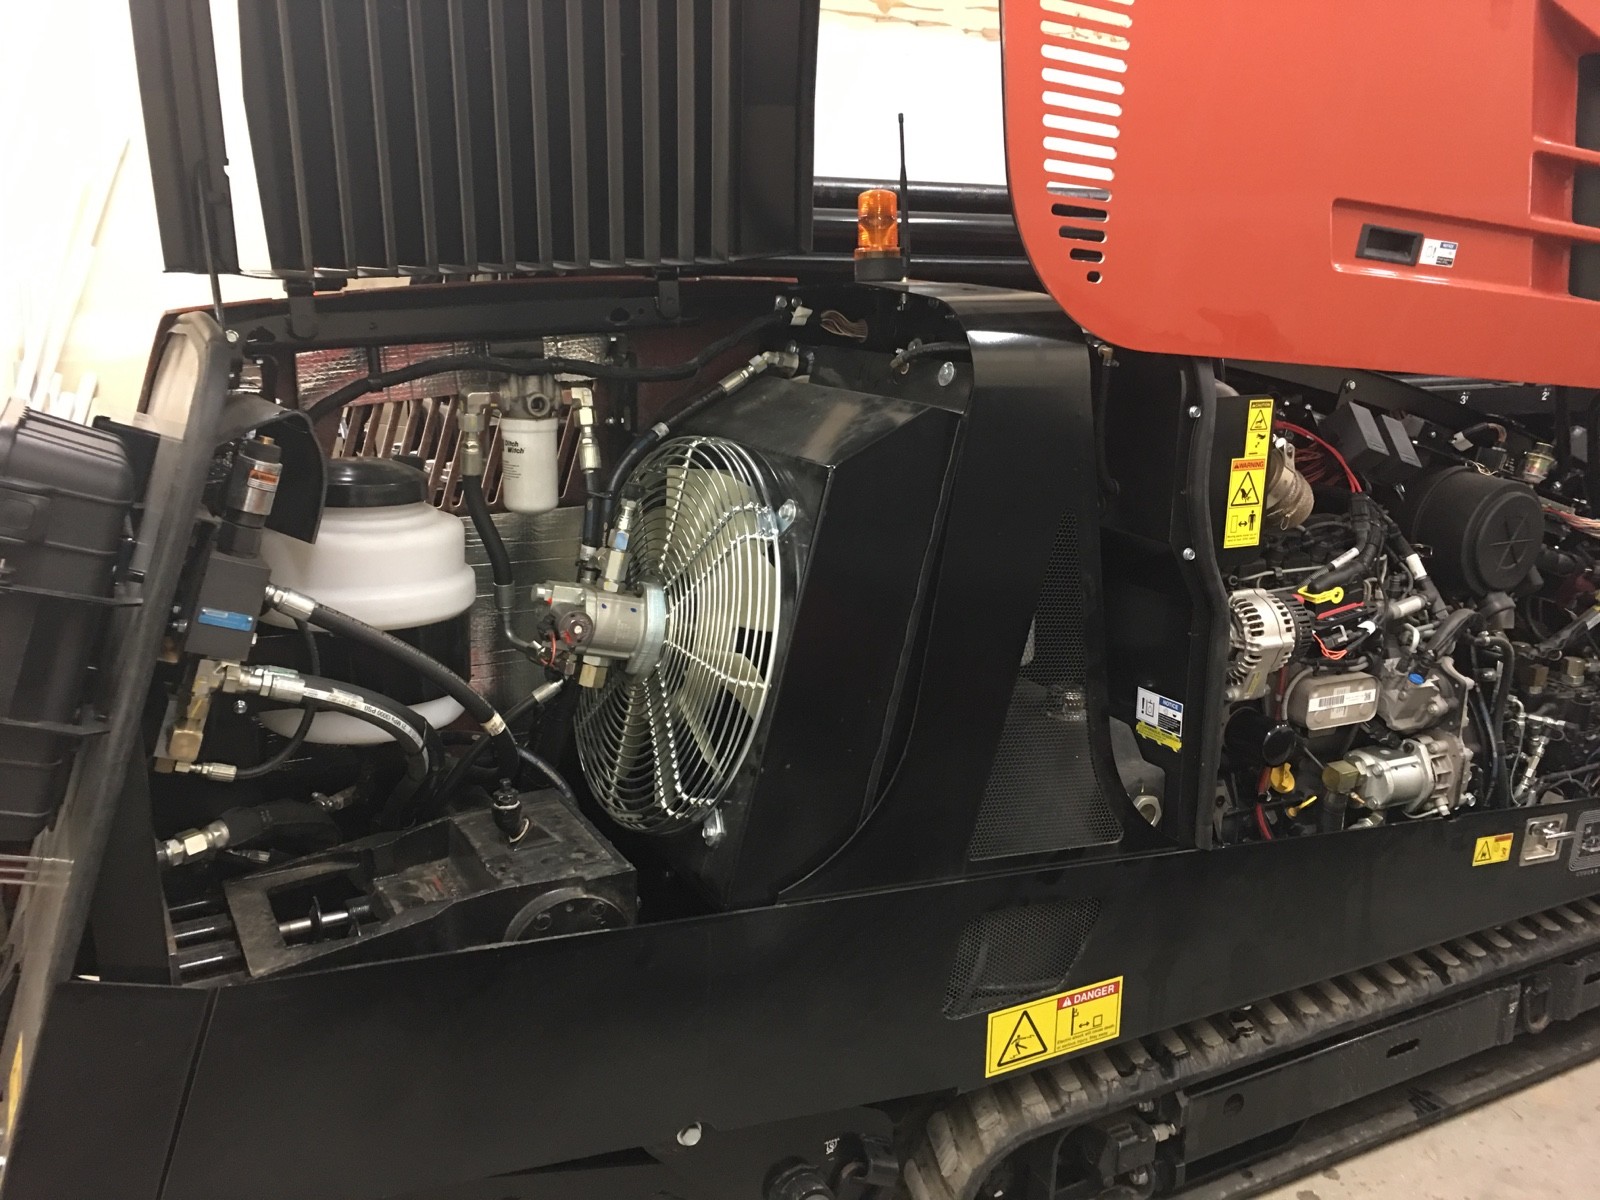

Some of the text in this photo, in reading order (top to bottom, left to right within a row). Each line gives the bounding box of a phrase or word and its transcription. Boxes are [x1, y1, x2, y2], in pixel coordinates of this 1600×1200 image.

[1239, 461, 1264, 469] WARNING
[1162, 700, 1179, 711] NOTICE
[1073, 984, 1115, 1005] DANGER
